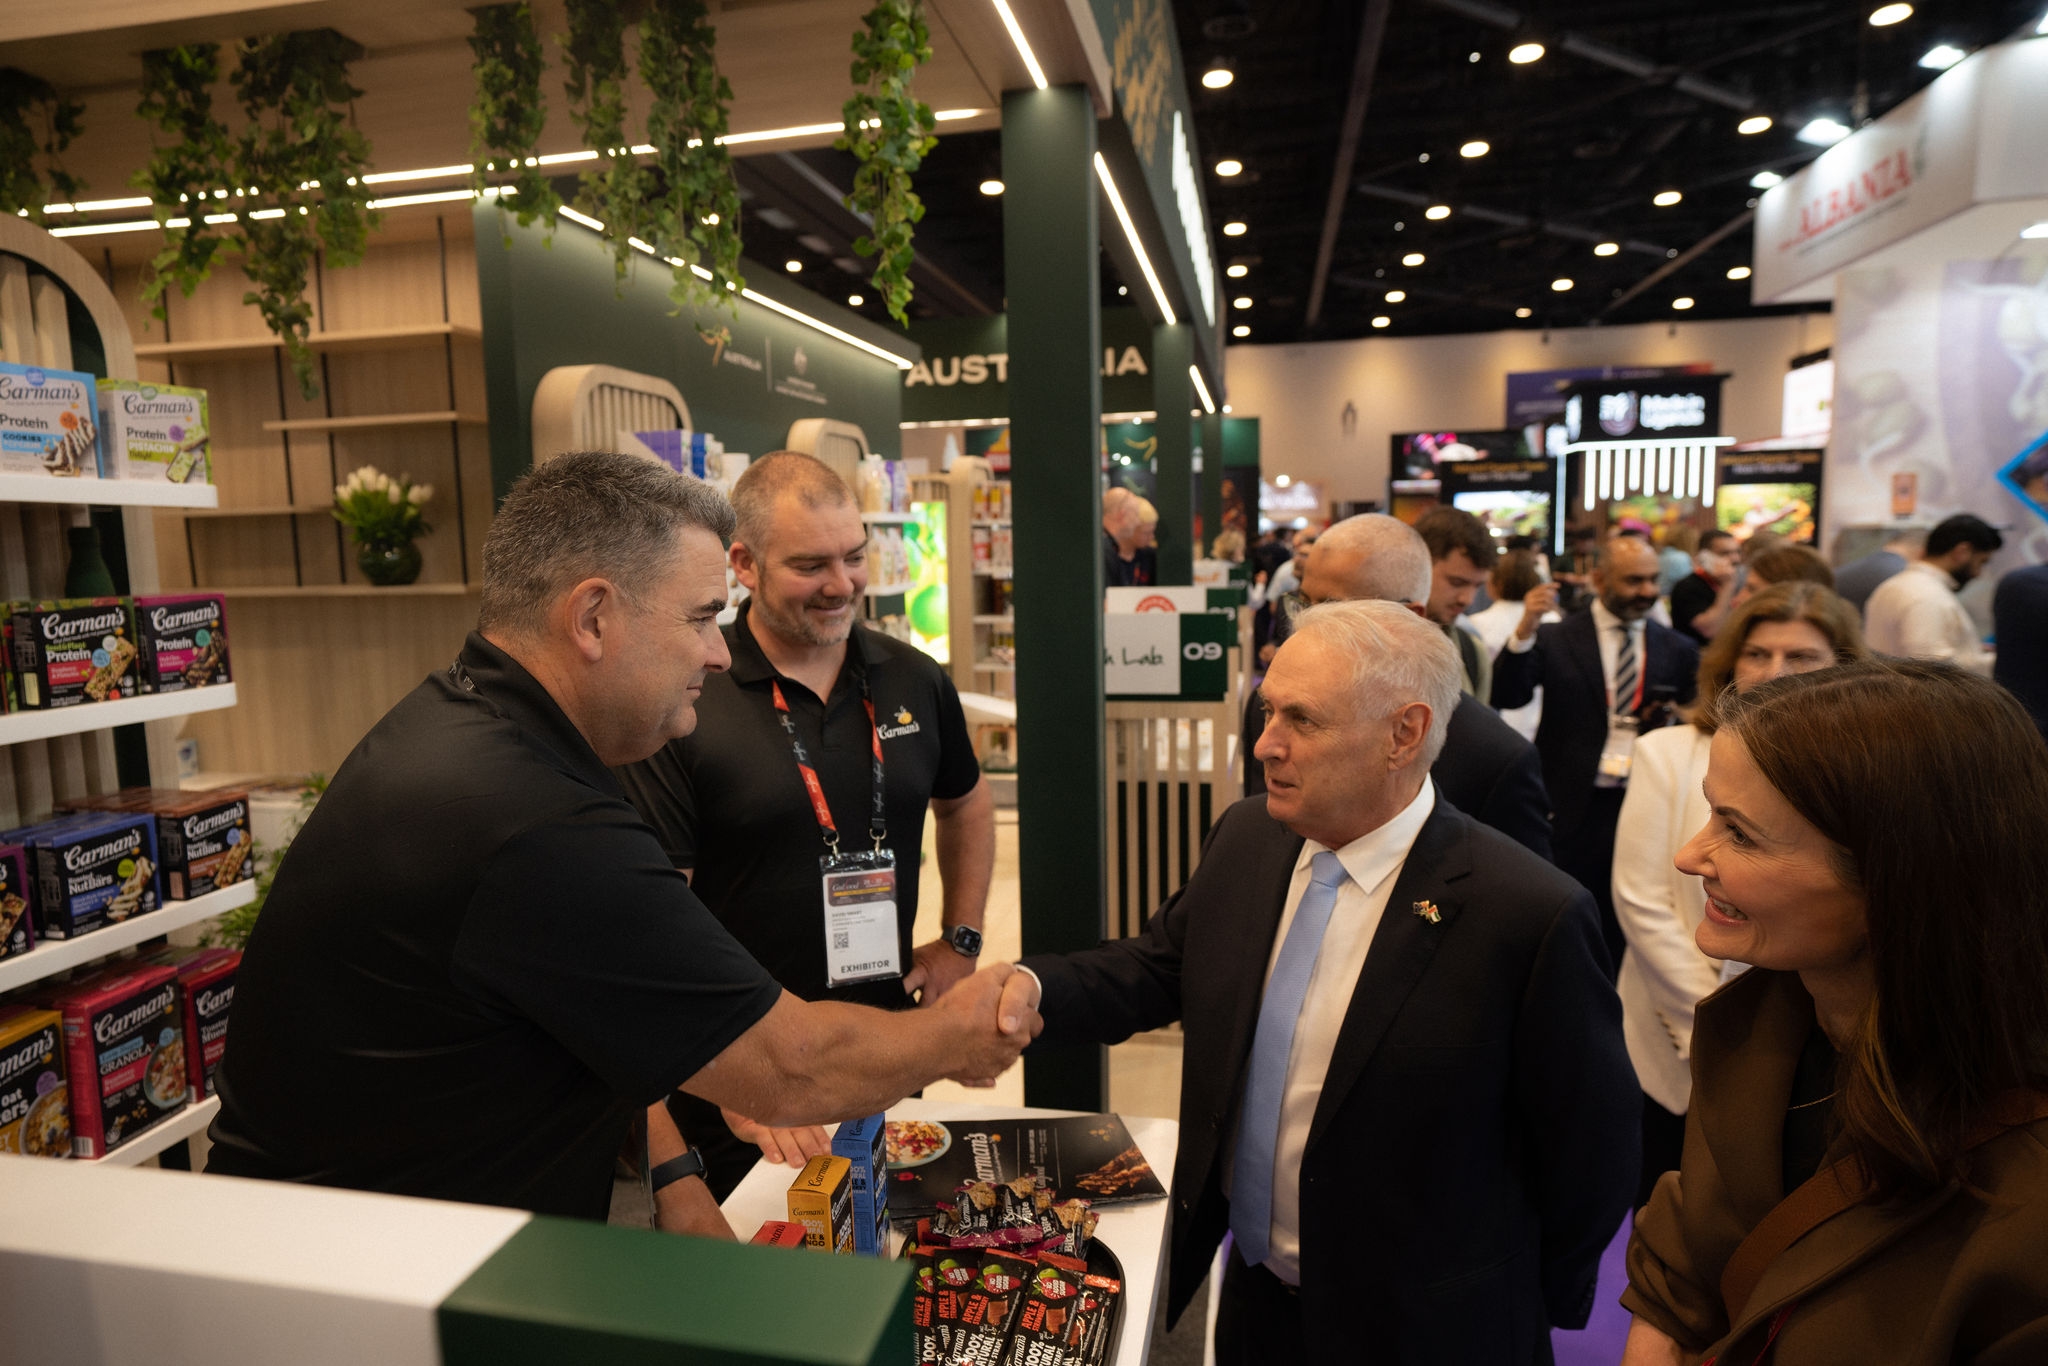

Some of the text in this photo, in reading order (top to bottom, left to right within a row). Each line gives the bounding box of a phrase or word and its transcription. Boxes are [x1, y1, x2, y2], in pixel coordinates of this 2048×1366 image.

[904, 346, 1148, 387] AUSTIA
[0, 376, 80, 401] Carman's
[122, 393, 193, 415] Carman's
[0, 414, 48, 430] Protein
[126, 427, 166, 441] Protein
[41, 607, 125, 640] Carman's
[150, 601, 220, 631] Carman's
[46, 648, 91, 664] Protein
[155, 637, 193, 651] Protein
[1183, 642, 1223, 661] 09
[876, 721, 920, 740] Carman's
[183, 801, 245, 839] Carman's
[64, 828, 142, 871] Carman's
[841, 959, 890, 974] EXHIBITOR
[94, 984, 174, 1043] Carman's
[0, 1029, 54, 1078] man's
[100, 1043, 152, 1075] GRANOLA
[807, 1157, 833, 1187] Carman's
[792, 1207, 825, 1216] Carman's
[1041, 1216, 1052, 1234] Bite
[1064, 1232, 1074, 1253] Bite
[938, 1297, 949, 1319] APPLE
[962, 1300, 980, 1323] APPLE
[1021, 1307, 1037, 1330] APPLE
[922, 1335, 937, 1363] 100%
[944, 1329, 966, 1366] Carman's
[963, 1333, 985, 1361] 100%
[974, 1335, 996, 1366] ATURAL
